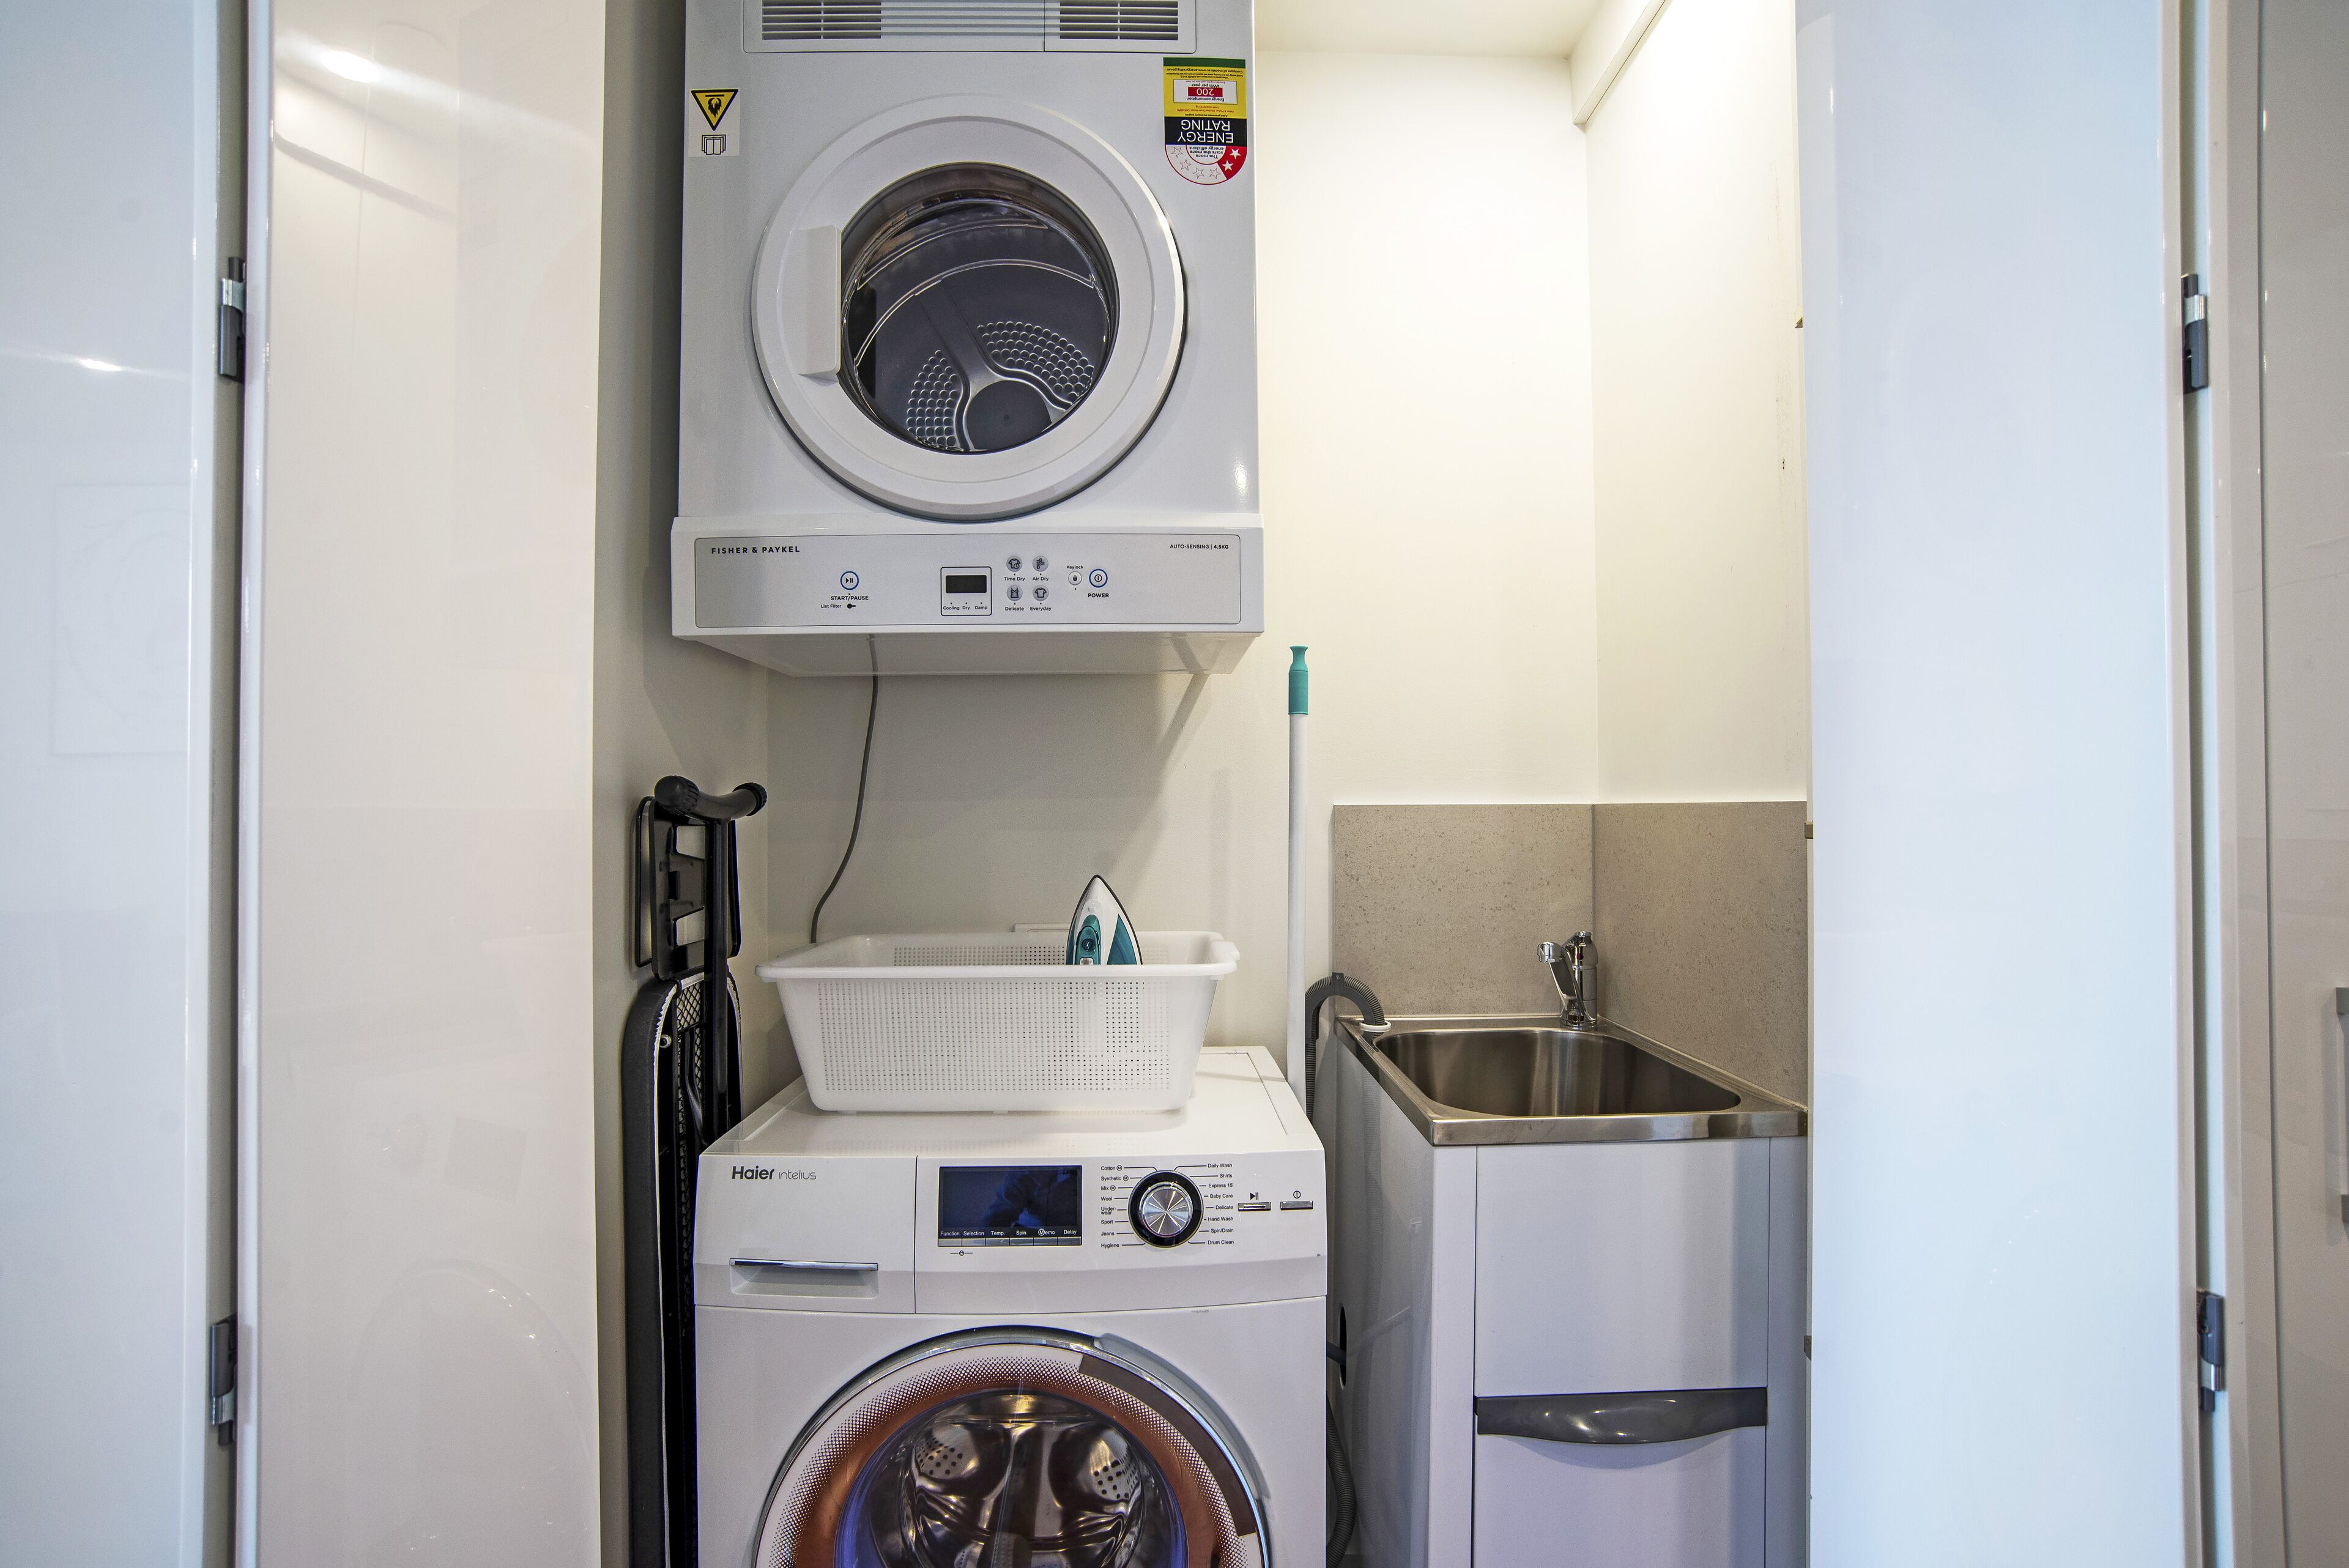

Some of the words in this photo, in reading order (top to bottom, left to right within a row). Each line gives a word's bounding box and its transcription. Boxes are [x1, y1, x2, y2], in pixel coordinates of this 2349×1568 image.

[1181, 119, 1230, 130] RATING
[1177, 132, 1234, 143] ENERGY
[732, 1165, 774, 1180] Haier
[779, 1170, 817, 1180] intelius
